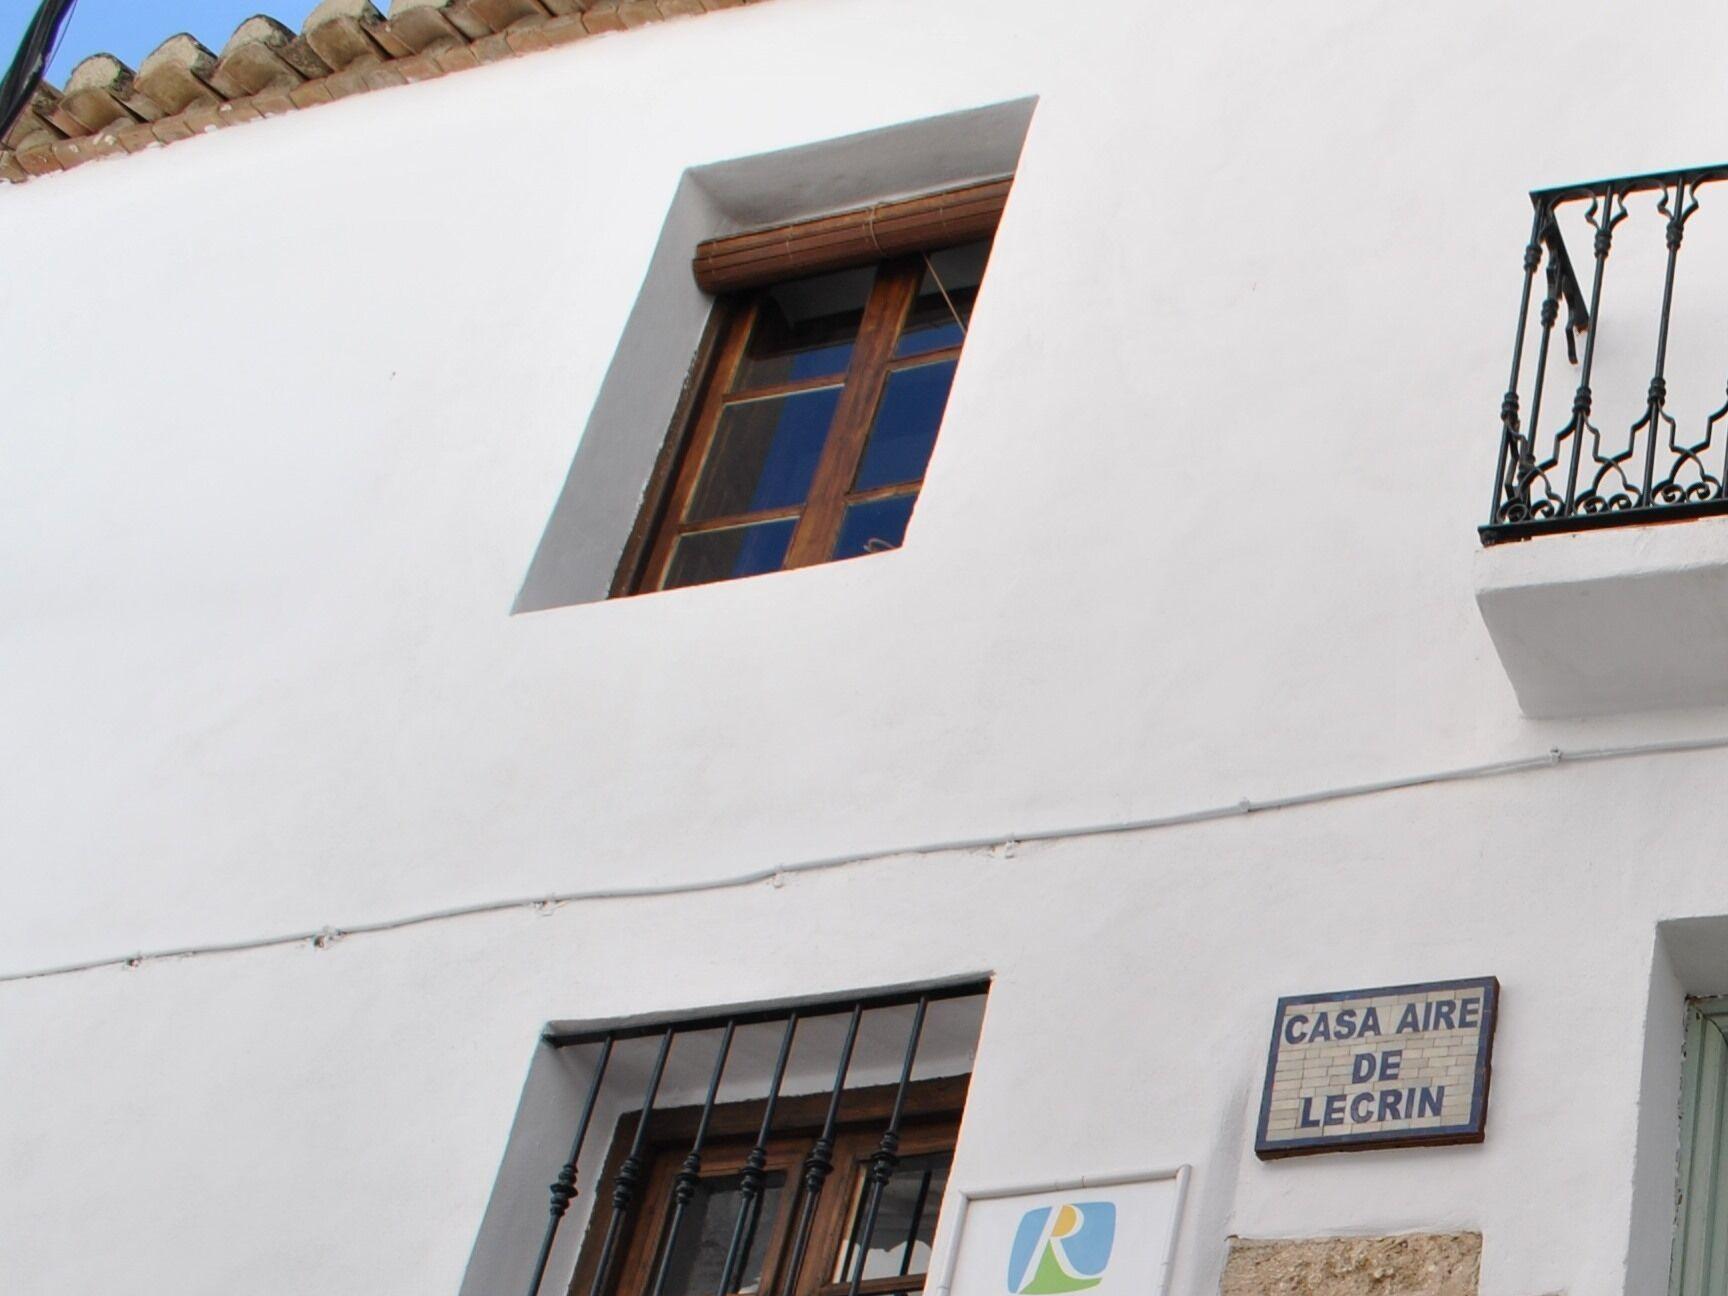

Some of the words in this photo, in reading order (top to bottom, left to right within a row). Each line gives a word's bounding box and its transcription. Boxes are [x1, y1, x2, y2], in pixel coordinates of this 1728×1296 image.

[1284, 1006, 1381, 1045] CASA
[1396, 997, 1481, 1035] AIRE
[1351, 1049, 1403, 1084] DE
[1300, 1085, 1446, 1128] LECRIN
